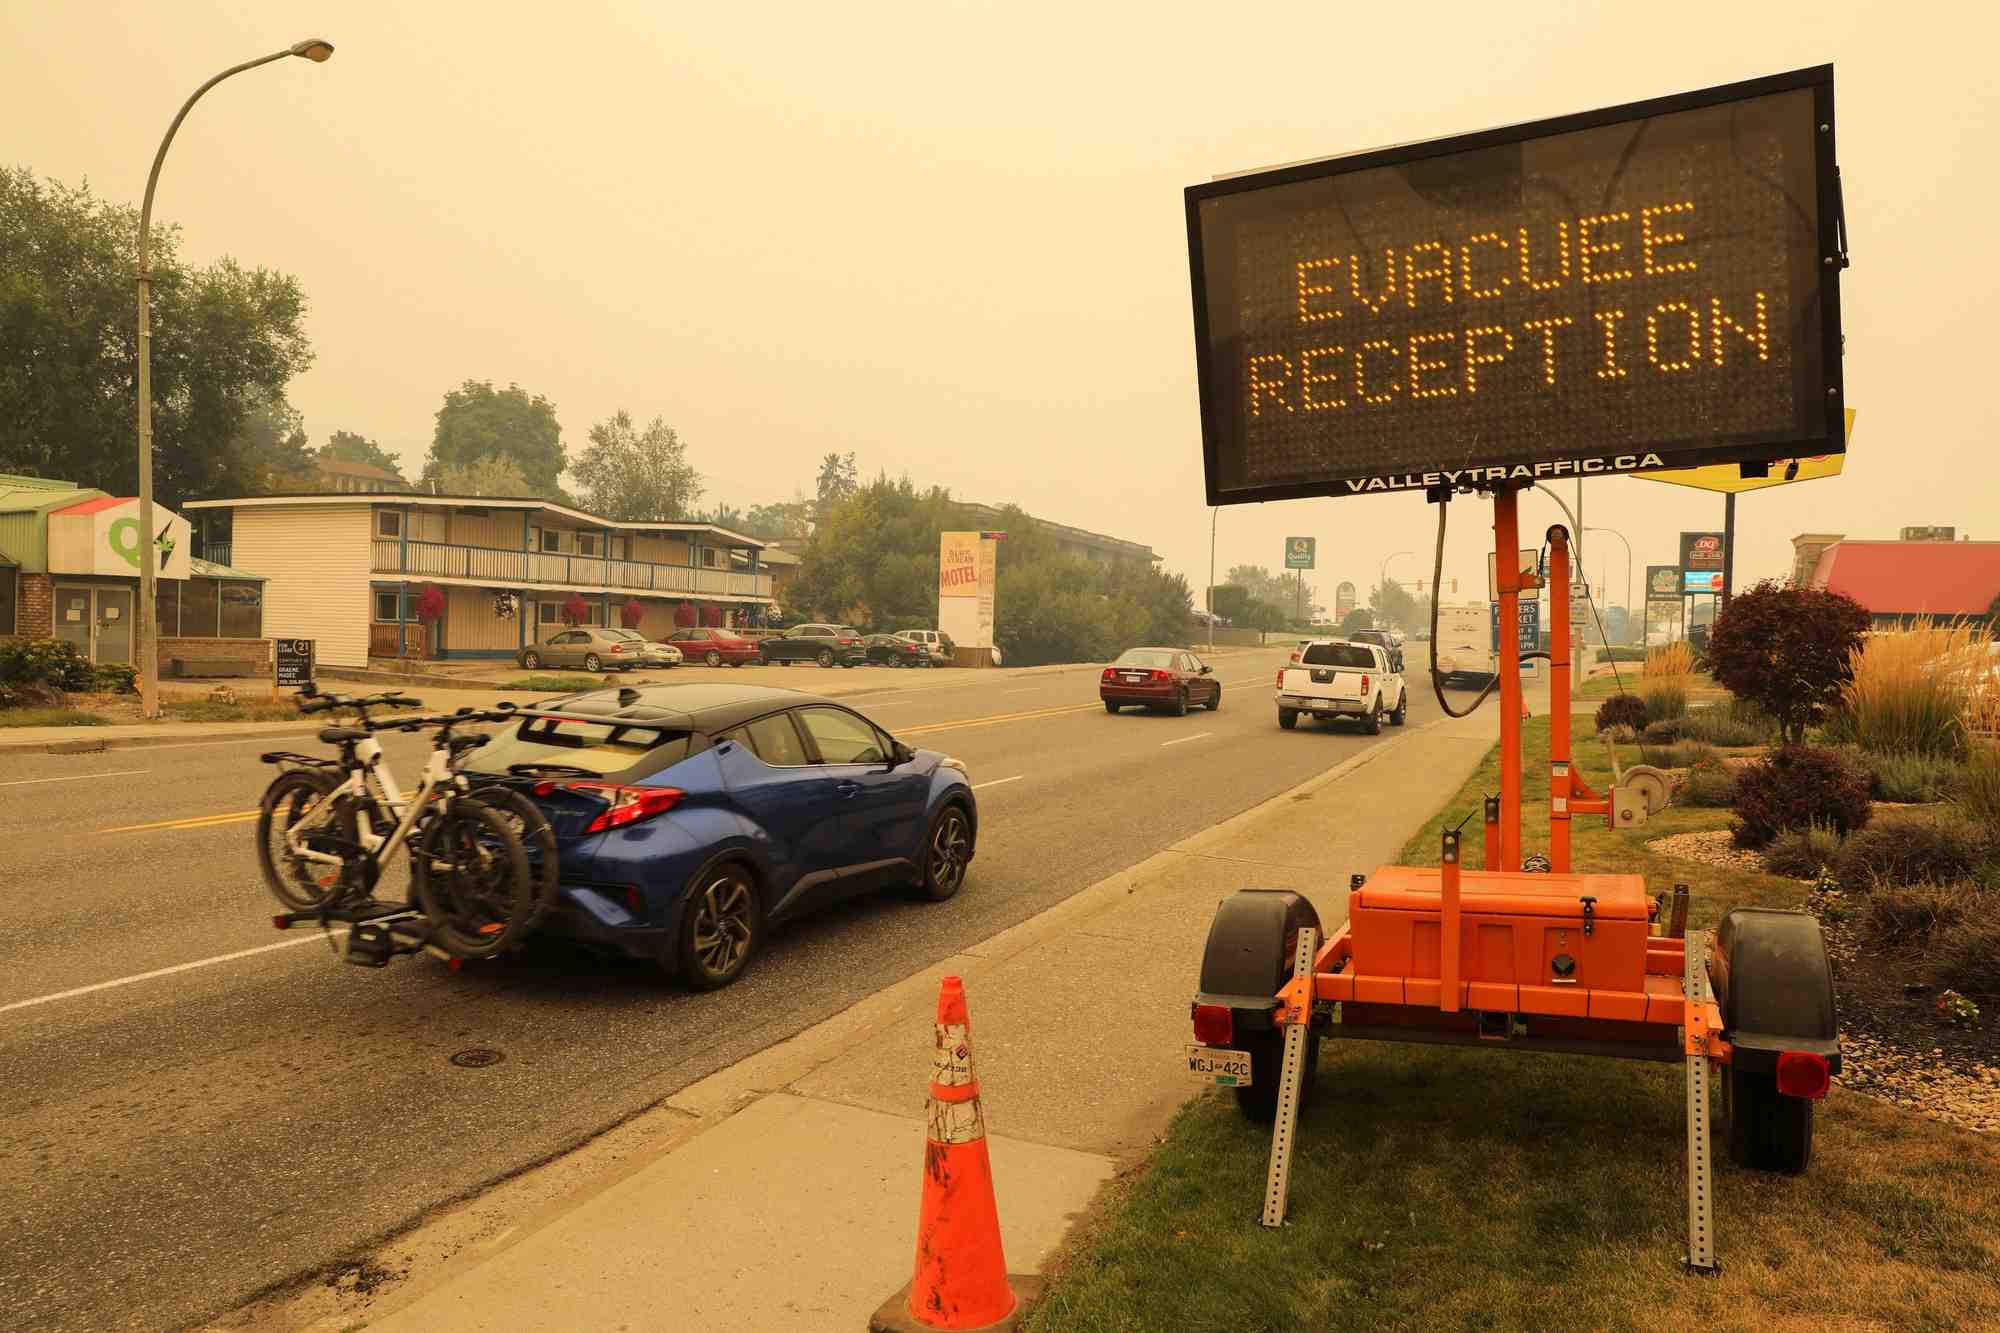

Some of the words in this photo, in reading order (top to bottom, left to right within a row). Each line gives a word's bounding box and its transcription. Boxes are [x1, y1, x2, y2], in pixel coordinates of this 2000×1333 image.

[1297, 201, 1696, 323] EVACUEE
[1250, 292, 1768, 416] RECEPTION
[1346, 453, 1664, 492] VALLEYTRAFFIC.CA
[942, 566, 976, 586] MOTEL
[298, 642, 309, 650] 21
